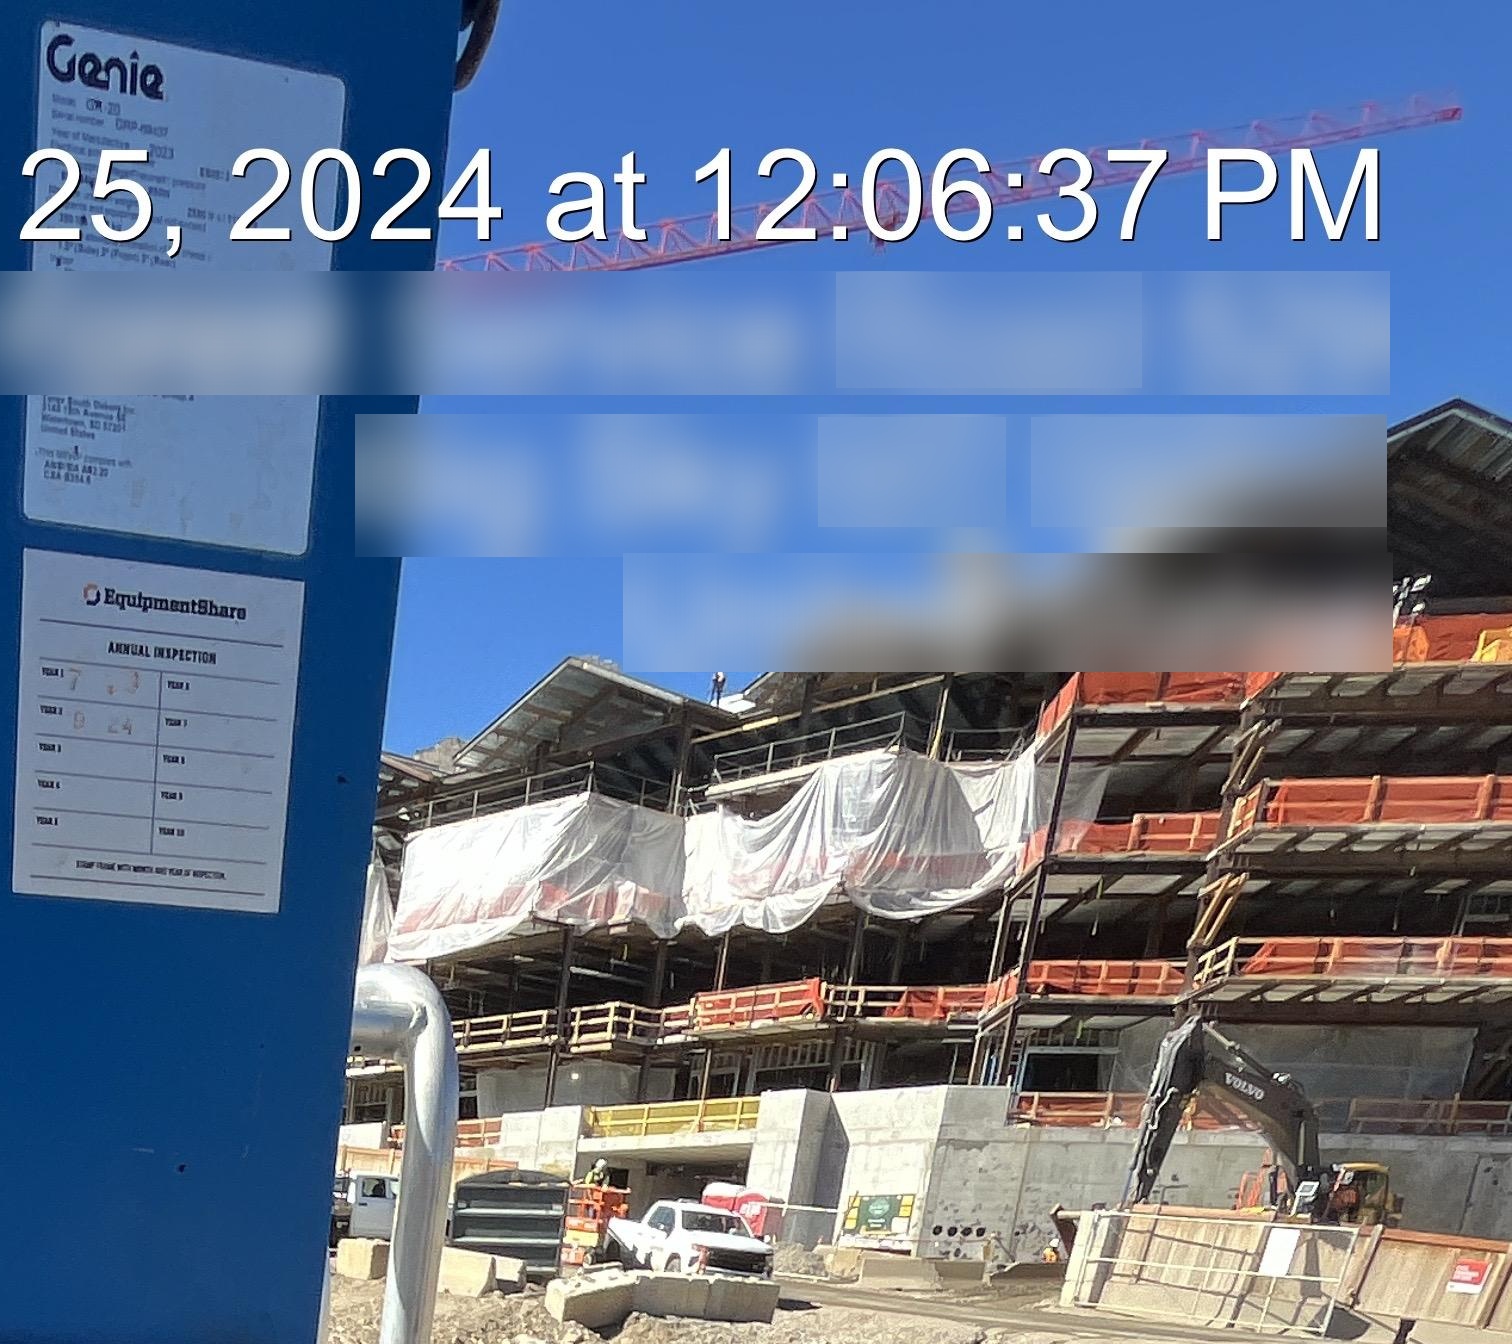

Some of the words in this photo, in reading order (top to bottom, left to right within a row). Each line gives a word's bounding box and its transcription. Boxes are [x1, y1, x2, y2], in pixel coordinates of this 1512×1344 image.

[46, 34, 165, 101] Genie
[103, 587, 247, 620] EquipmentShare
[108, 642, 151, 657] ANNUAL
[154, 647, 217, 664] INSPECTION
[1224, 1072, 1265, 1103] VOLVO
